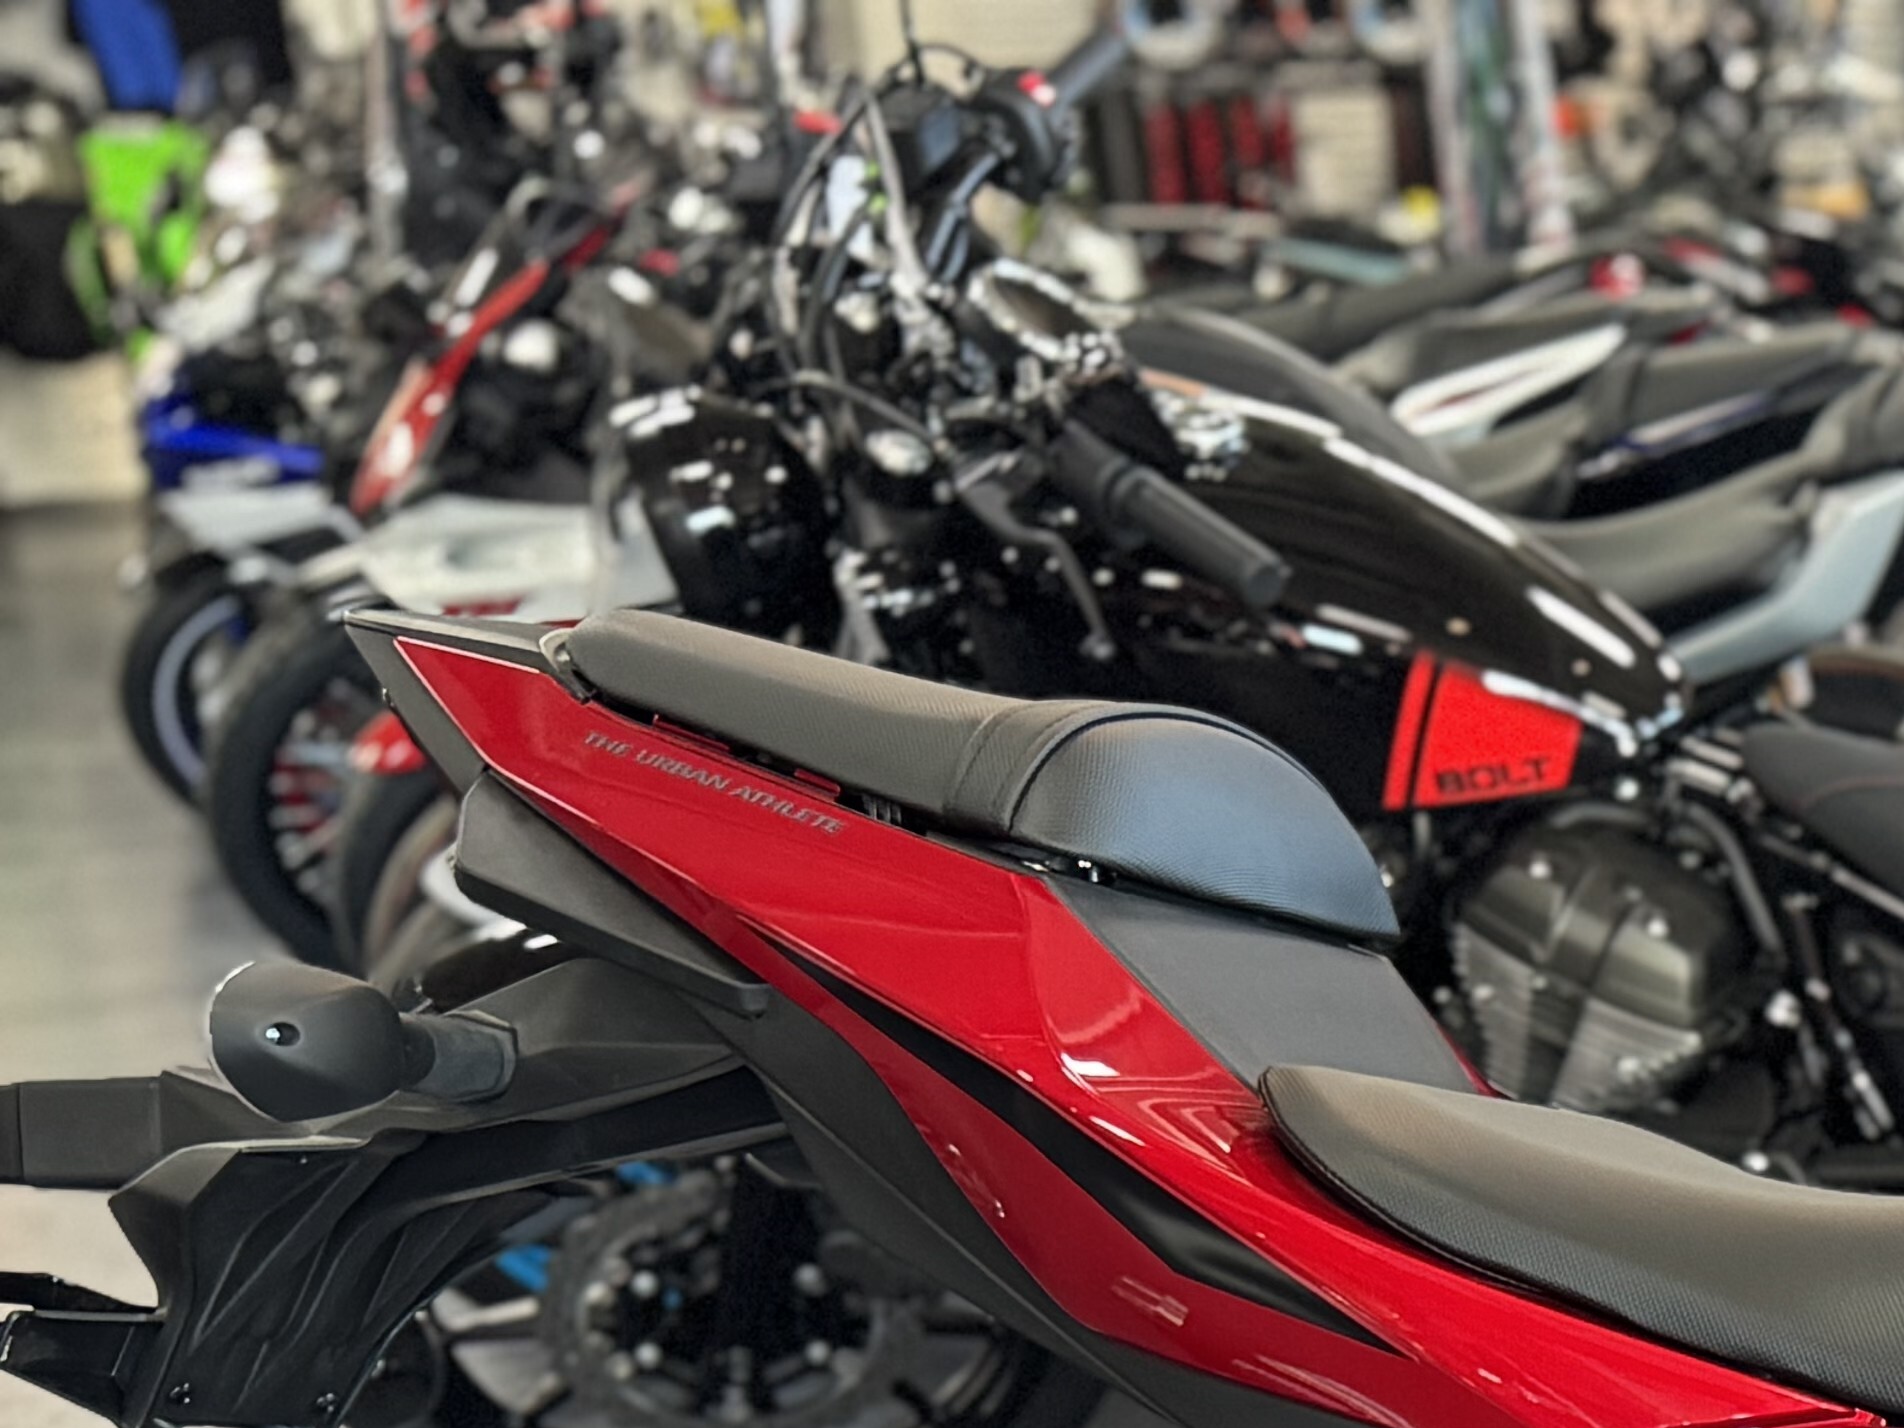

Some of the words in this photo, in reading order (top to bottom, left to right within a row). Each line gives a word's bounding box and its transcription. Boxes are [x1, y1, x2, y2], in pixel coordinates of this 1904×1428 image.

[584, 731, 631, 759] THE
[637, 748, 729, 792] URBAN
[729, 785, 848, 835] ATHLETE
[1436, 757, 1549, 793] BOLT
